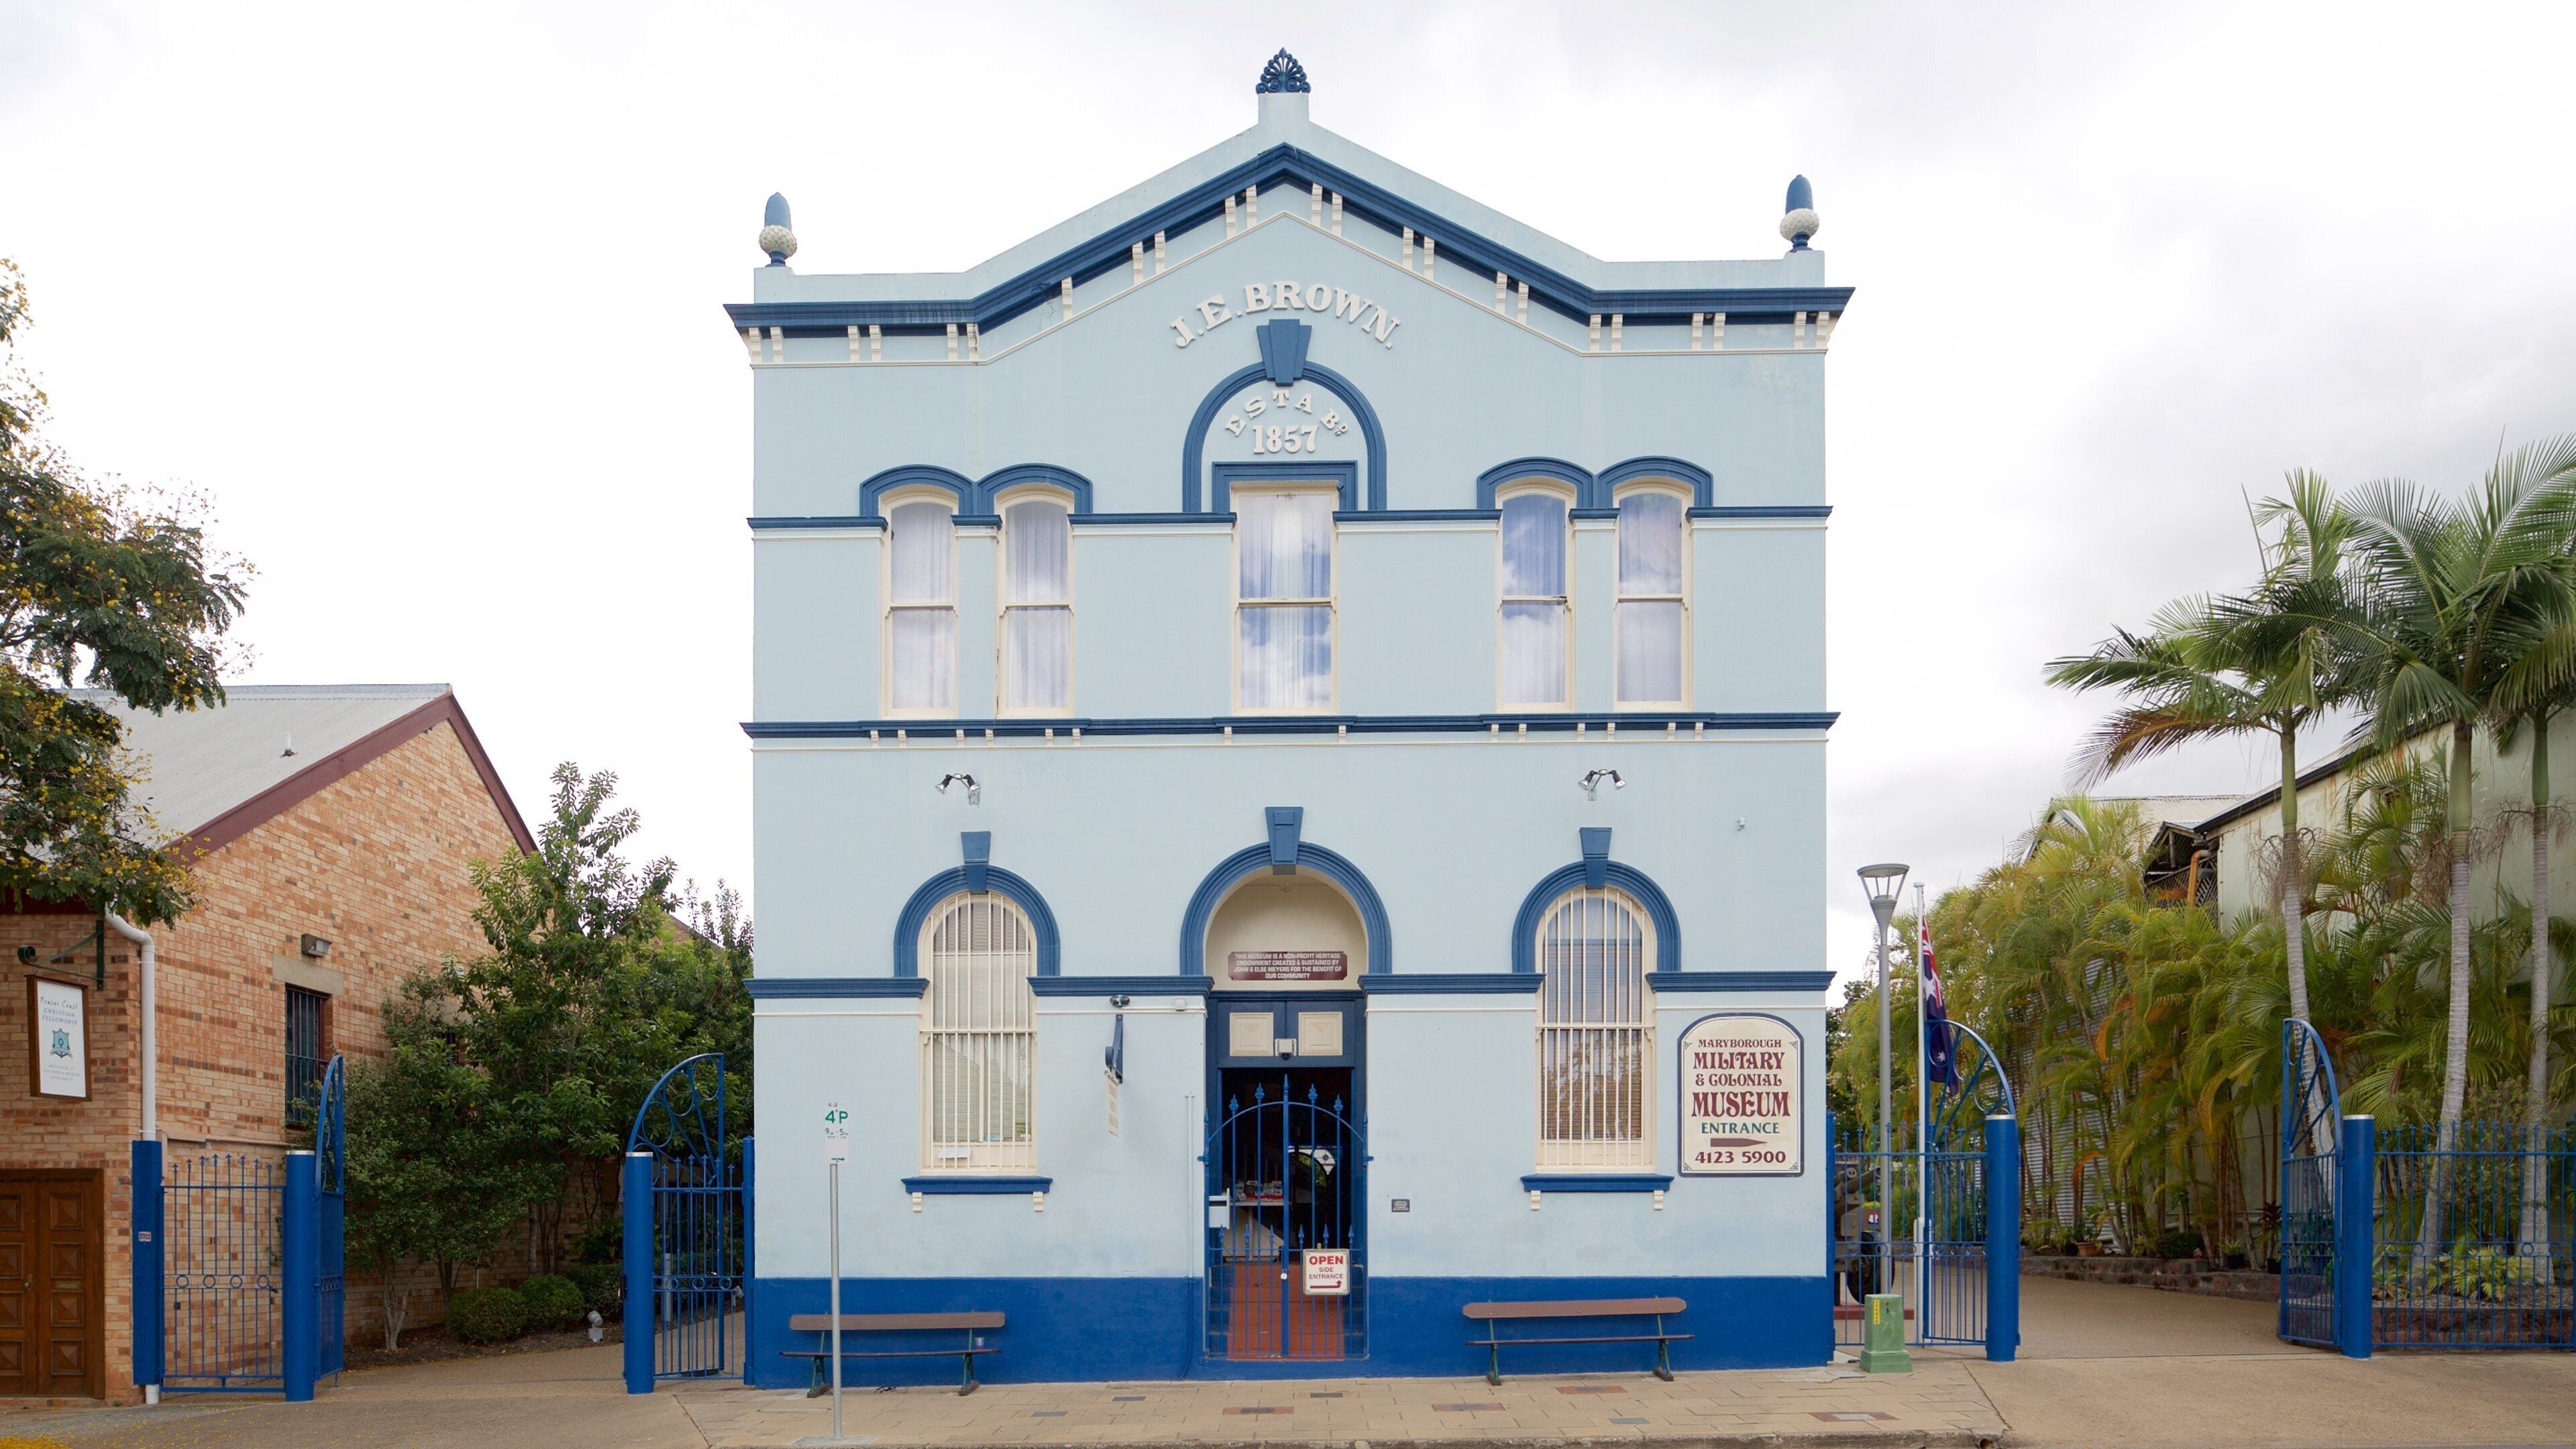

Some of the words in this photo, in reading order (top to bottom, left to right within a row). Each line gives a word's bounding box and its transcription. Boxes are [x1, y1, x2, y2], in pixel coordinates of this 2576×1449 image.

[1252, 425, 1319, 453] 1857
[44, 1008, 76, 1018] CHRISTIAN
[42, 1014, 77, 1026] FELLOWSHIP
[1698, 1039, 1782, 1048] MARYBOROUGH
[1693, 1052, 1785, 1070] MILITARY
[1695, 1073, 1705, 1086] &
[1709, 1073, 1782, 1086] COLONIAL
[1691, 1091, 1790, 1118] MUSEUM
[825, 1110, 849, 1124] 4P
[1701, 1122, 1780, 1134] ENTRANCE
[1695, 1151, 1734, 1163] 4123
[1741, 1151, 1786, 1163] 5900
[1309, 1256, 1344, 1265] OPEN
